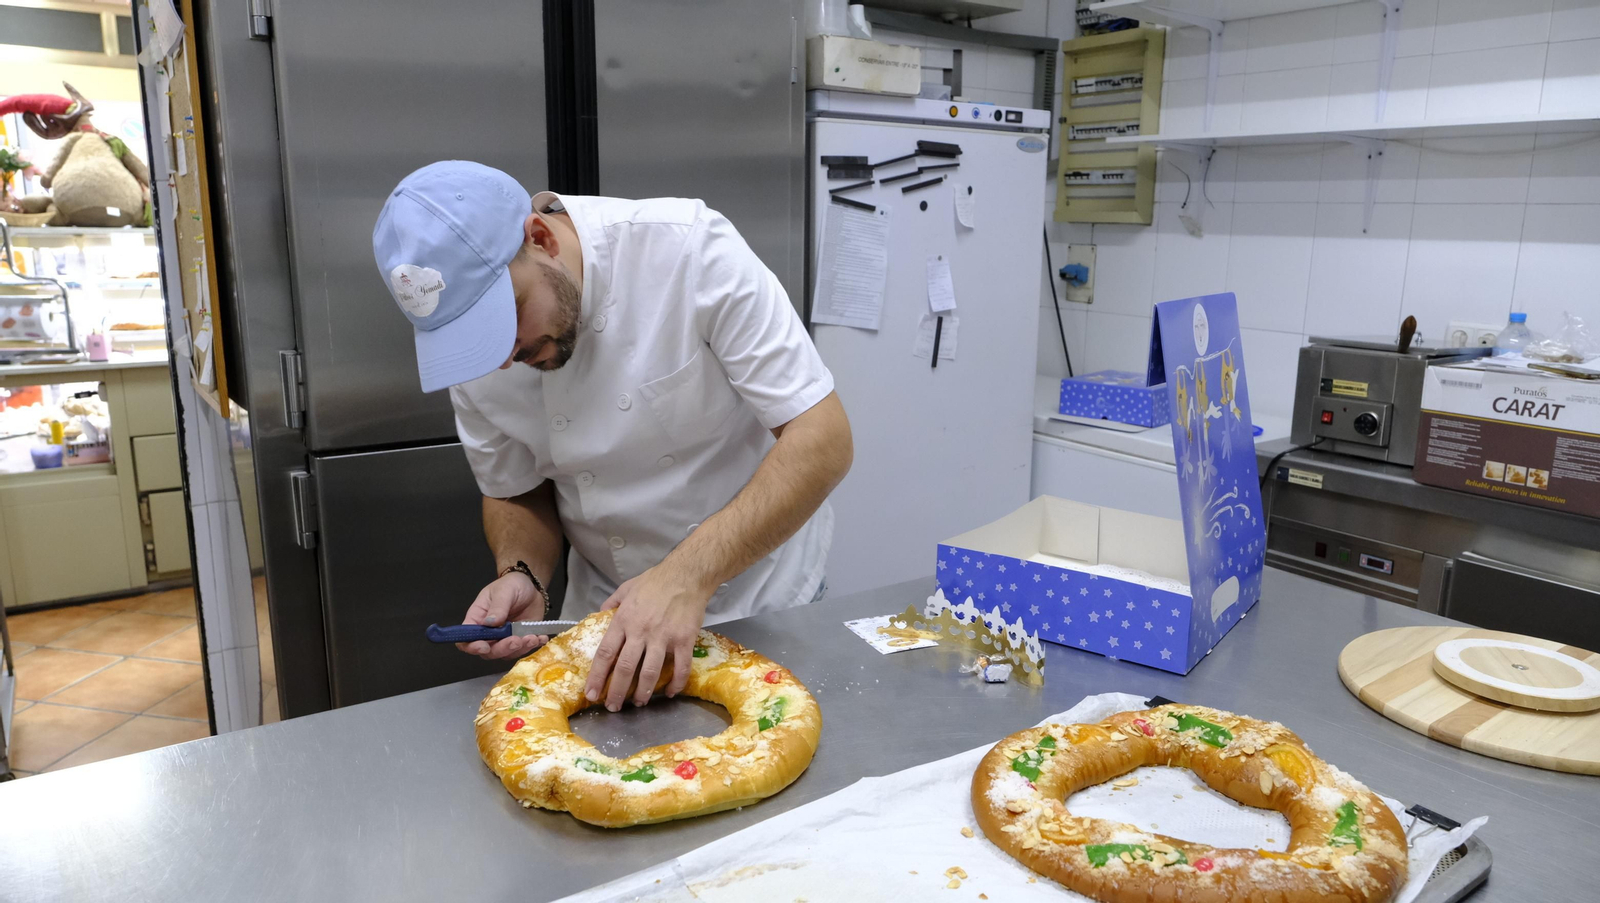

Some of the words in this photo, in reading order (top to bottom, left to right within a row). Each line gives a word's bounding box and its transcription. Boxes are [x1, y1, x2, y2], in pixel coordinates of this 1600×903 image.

[1513, 386, 1548, 398] Puratos
[1492, 397, 1566, 421] CARAT
[1465, 478, 1491, 490] Reliable
[1491, 485, 1519, 495] partners
[1520, 489, 1528, 497] in
[1529, 491, 1566, 504] innovation
